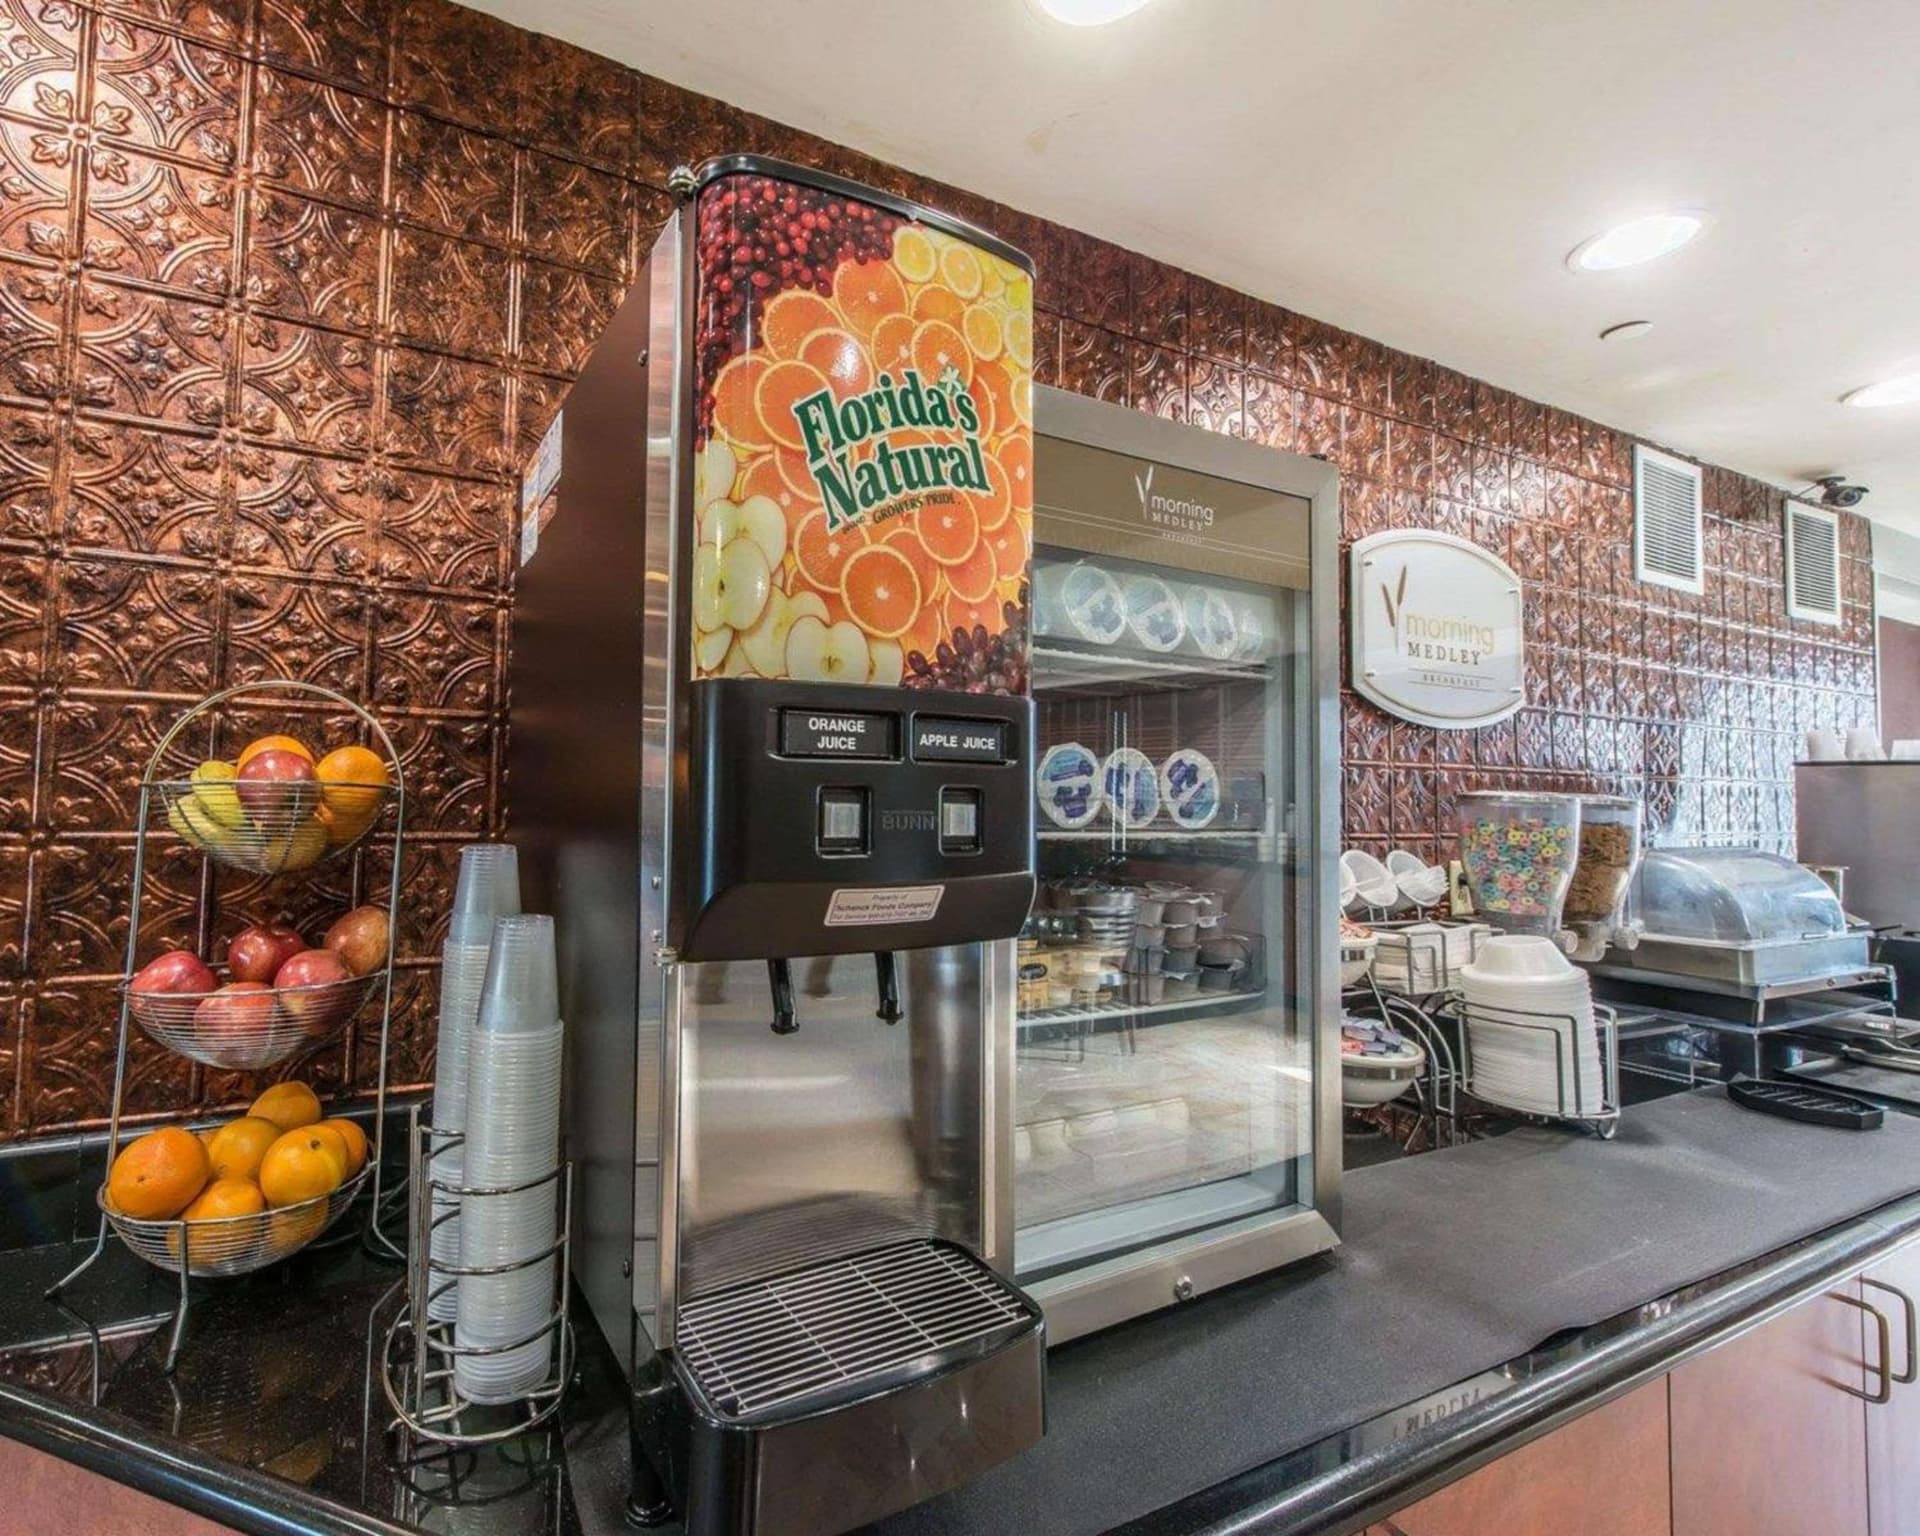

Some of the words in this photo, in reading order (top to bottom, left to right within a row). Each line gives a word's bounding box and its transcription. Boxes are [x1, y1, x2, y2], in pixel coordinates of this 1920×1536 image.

[793, 370, 980, 464] Florida's
[813, 437, 993, 529] Natural
[1151, 495, 1214, 526] morning
[1152, 512, 1203, 531] MEDLEY
[1406, 614, 1496, 655] morning
[1407, 641, 1482, 666] MEDLEY
[808, 717, 866, 733] ORANGE
[817, 735, 857, 750] JUICE
[919, 733, 958, 748] APPLE
[962, 735, 996, 750] JUICE
[881, 813, 936, 831] BUNN
